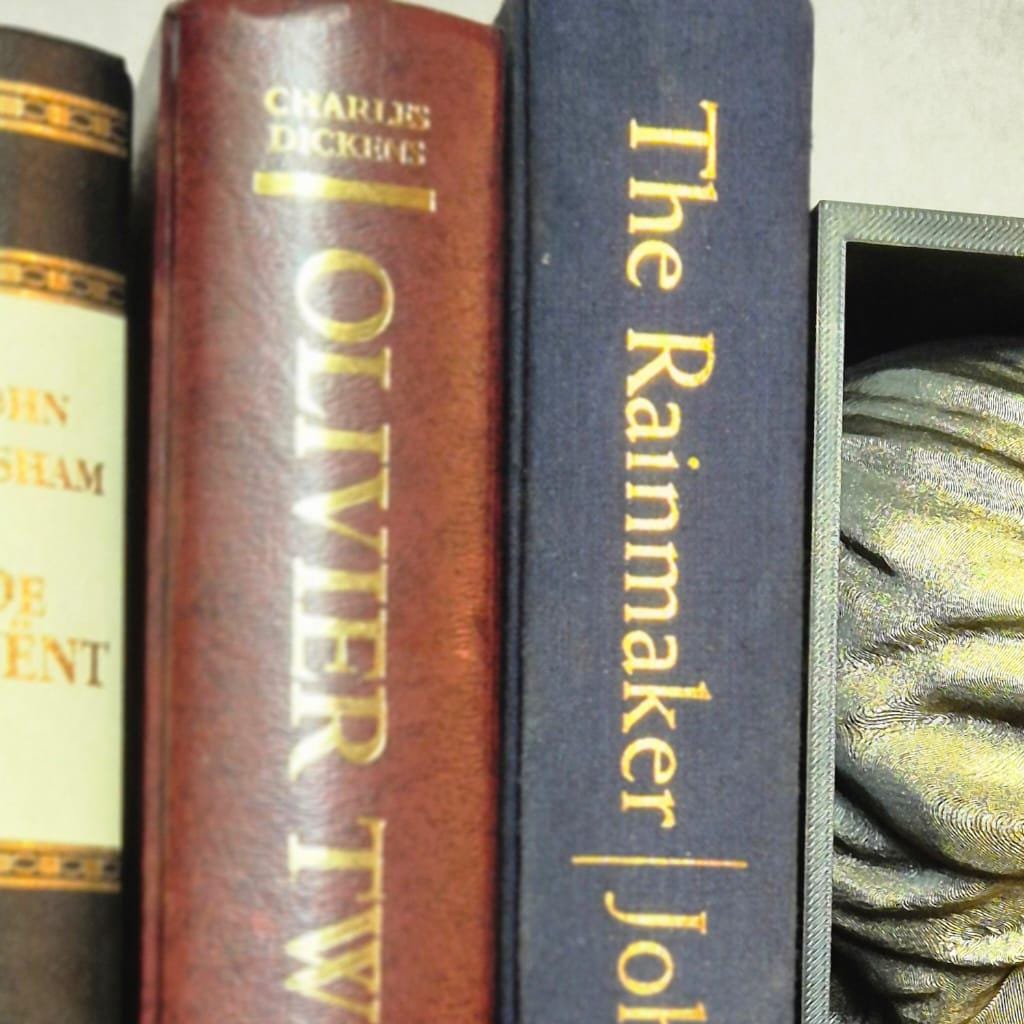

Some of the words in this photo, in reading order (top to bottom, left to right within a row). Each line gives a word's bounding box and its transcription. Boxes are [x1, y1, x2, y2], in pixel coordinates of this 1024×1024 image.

[263, 86, 431, 131] CHARLES
[267, 122, 427, 167] DICKENS
[625, 99, 719, 292] The
[0, 386, 69, 425] HN
[289, 247, 396, 781] OLIVER
[620, 329, 715, 830] Rainmaker
